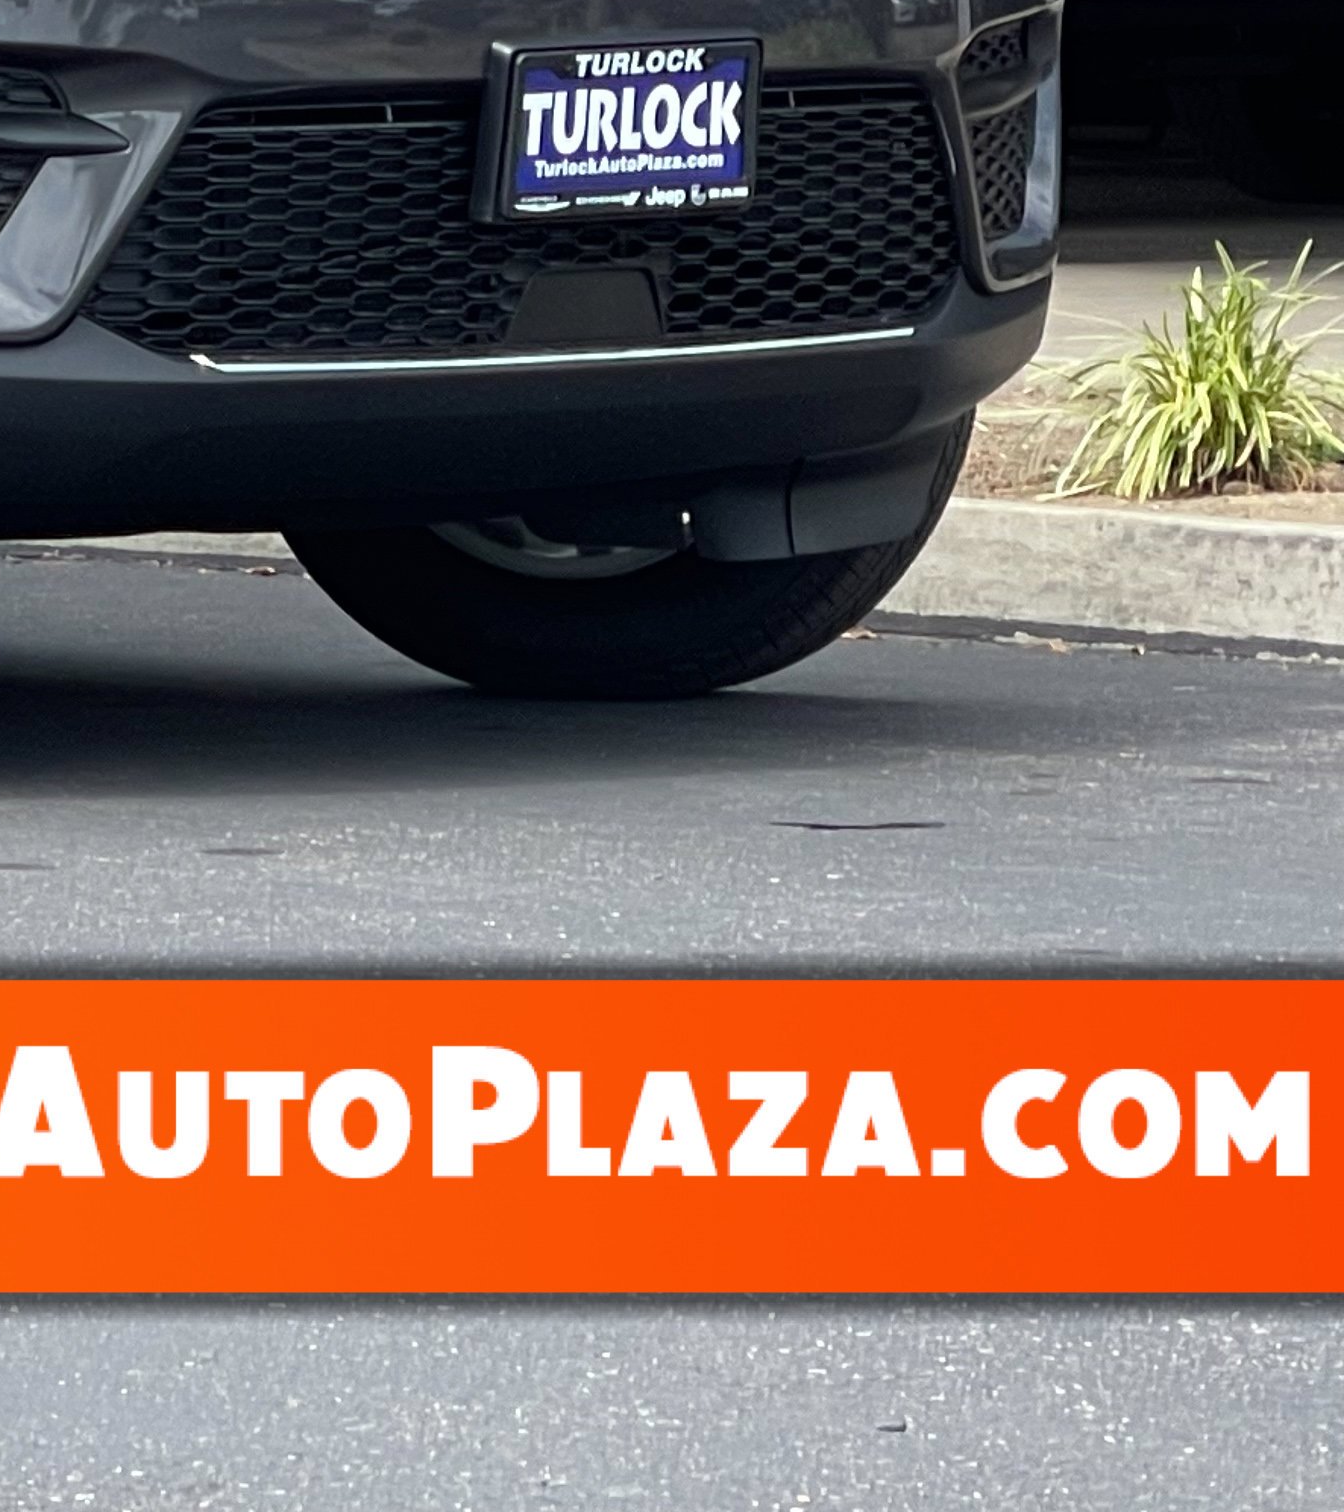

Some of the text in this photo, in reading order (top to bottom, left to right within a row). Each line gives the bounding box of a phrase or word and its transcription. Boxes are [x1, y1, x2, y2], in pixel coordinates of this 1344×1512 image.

[575, 47, 706, 77] TURLOCK
[522, 80, 743, 156] TURLOCK
[534, 153, 724, 178] TurlockAutoPlaza.com
[645, 186, 686, 208] Jeep
